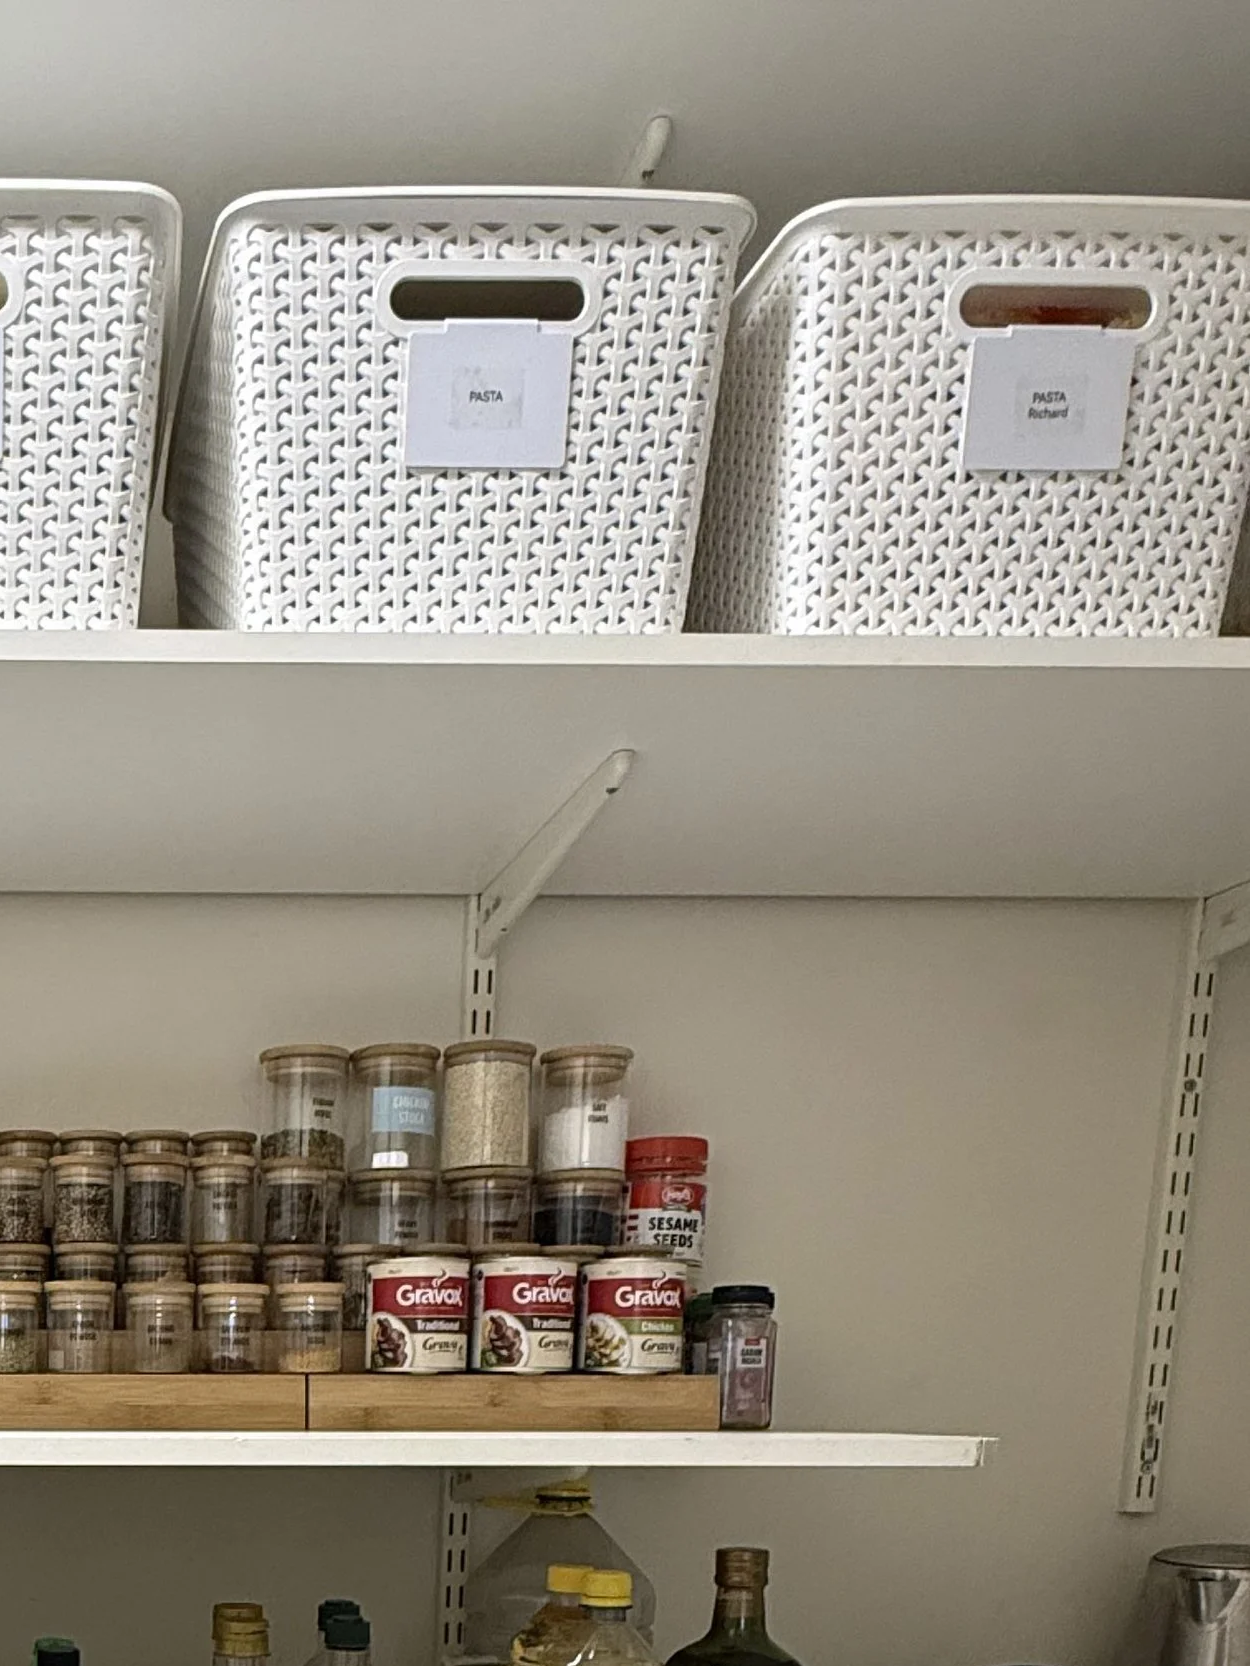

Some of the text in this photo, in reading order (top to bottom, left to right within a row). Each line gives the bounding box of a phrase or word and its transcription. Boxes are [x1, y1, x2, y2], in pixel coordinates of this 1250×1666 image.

[469, 389, 504, 403] PASTA
[1032, 391, 1067, 404] PASTA
[1028, 406, 1070, 420] Richard
[648, 1215, 699, 1233] SESAME
[653, 1233, 693, 1249] SEEDS
[396, 1283, 463, 1307] Gravox
[512, 1281, 574, 1306] Gravox
[615, 1284, 681, 1309] Gravox
[416, 1319, 460, 1331] Traditional
[641, 1320, 675, 1332] Chicken
[422, 1336, 458, 1353] Gravy
[640, 1337, 676, 1354] Gravy
